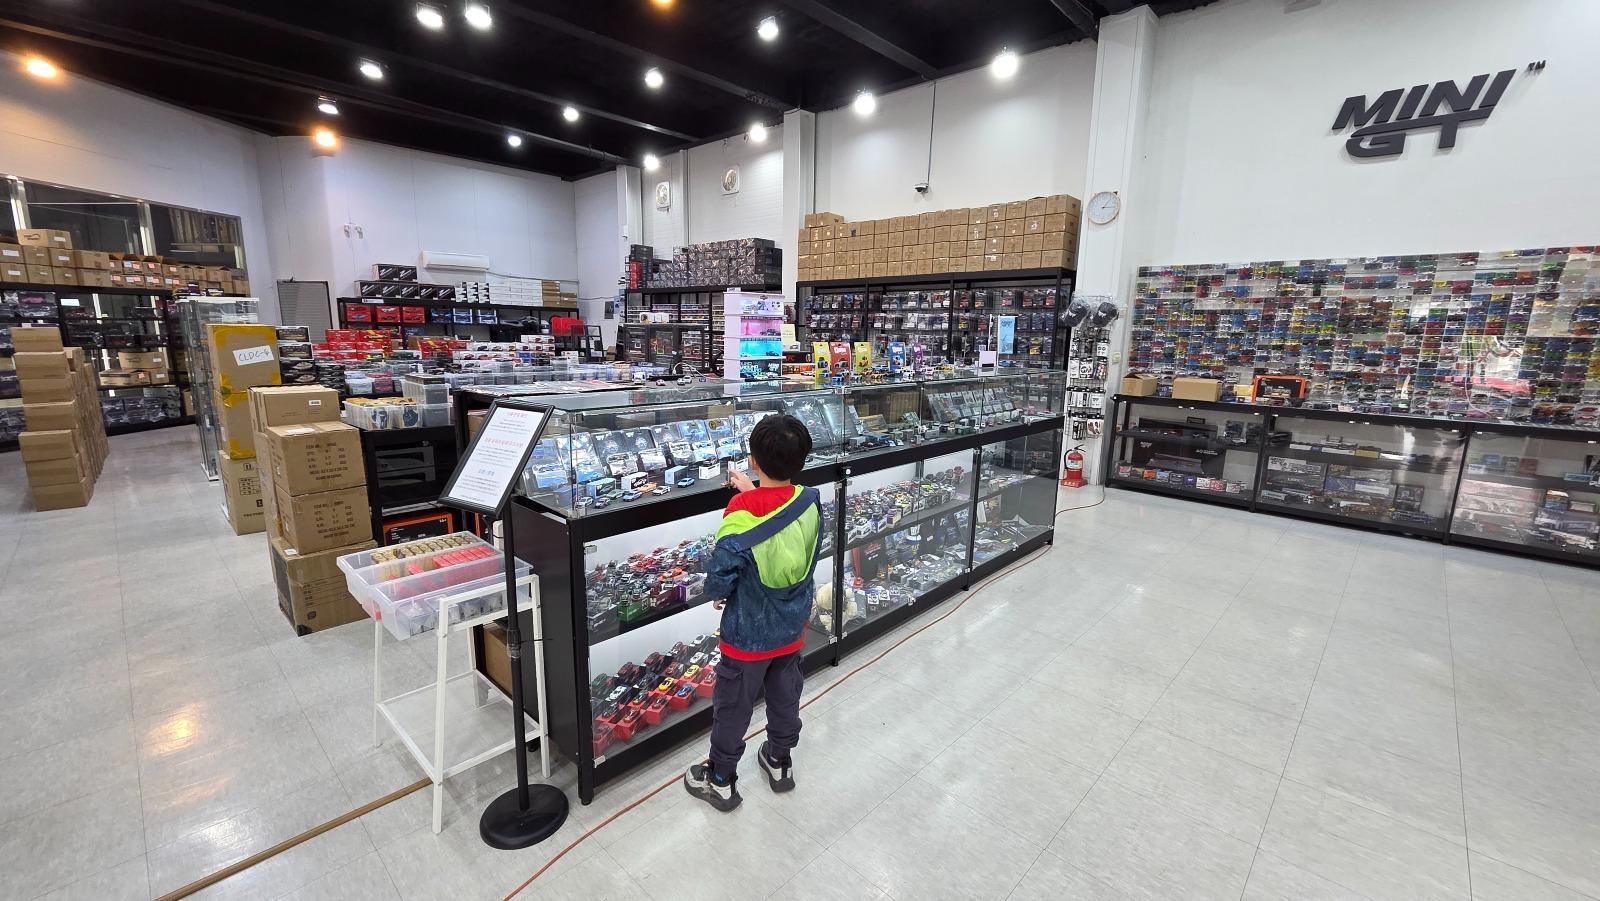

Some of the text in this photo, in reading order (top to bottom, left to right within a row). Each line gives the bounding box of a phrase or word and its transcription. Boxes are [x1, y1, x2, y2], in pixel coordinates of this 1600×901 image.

[1331, 59, 1547, 130] MINI TM
[1345, 105, 1497, 158] GT
